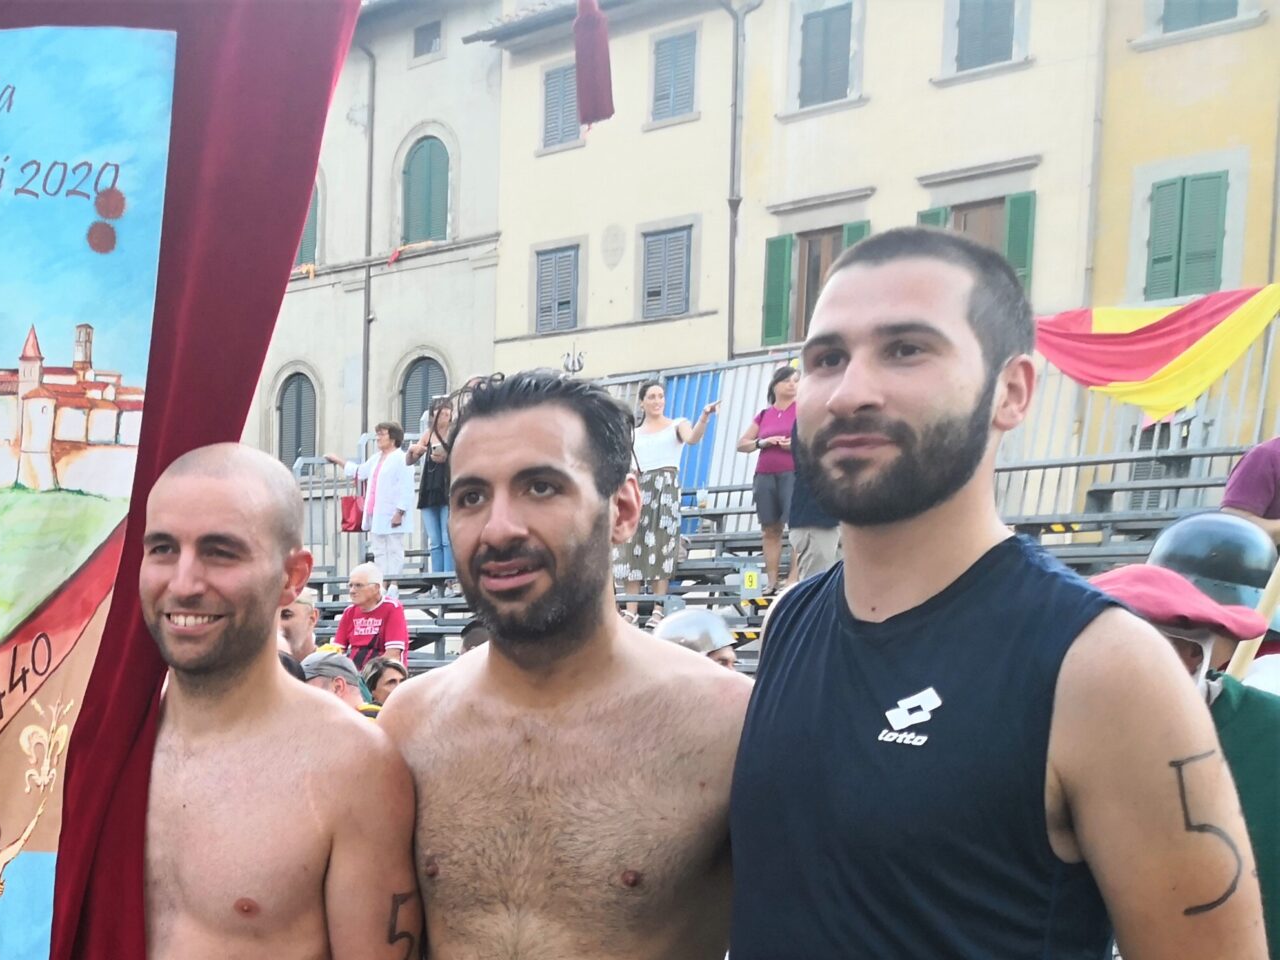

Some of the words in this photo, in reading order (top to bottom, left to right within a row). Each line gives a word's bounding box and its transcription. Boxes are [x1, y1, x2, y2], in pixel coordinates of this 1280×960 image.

[14, 159, 121, 201] 2020
[877, 729, 929, 746] lotto
[1169, 749, 1243, 916] 5
